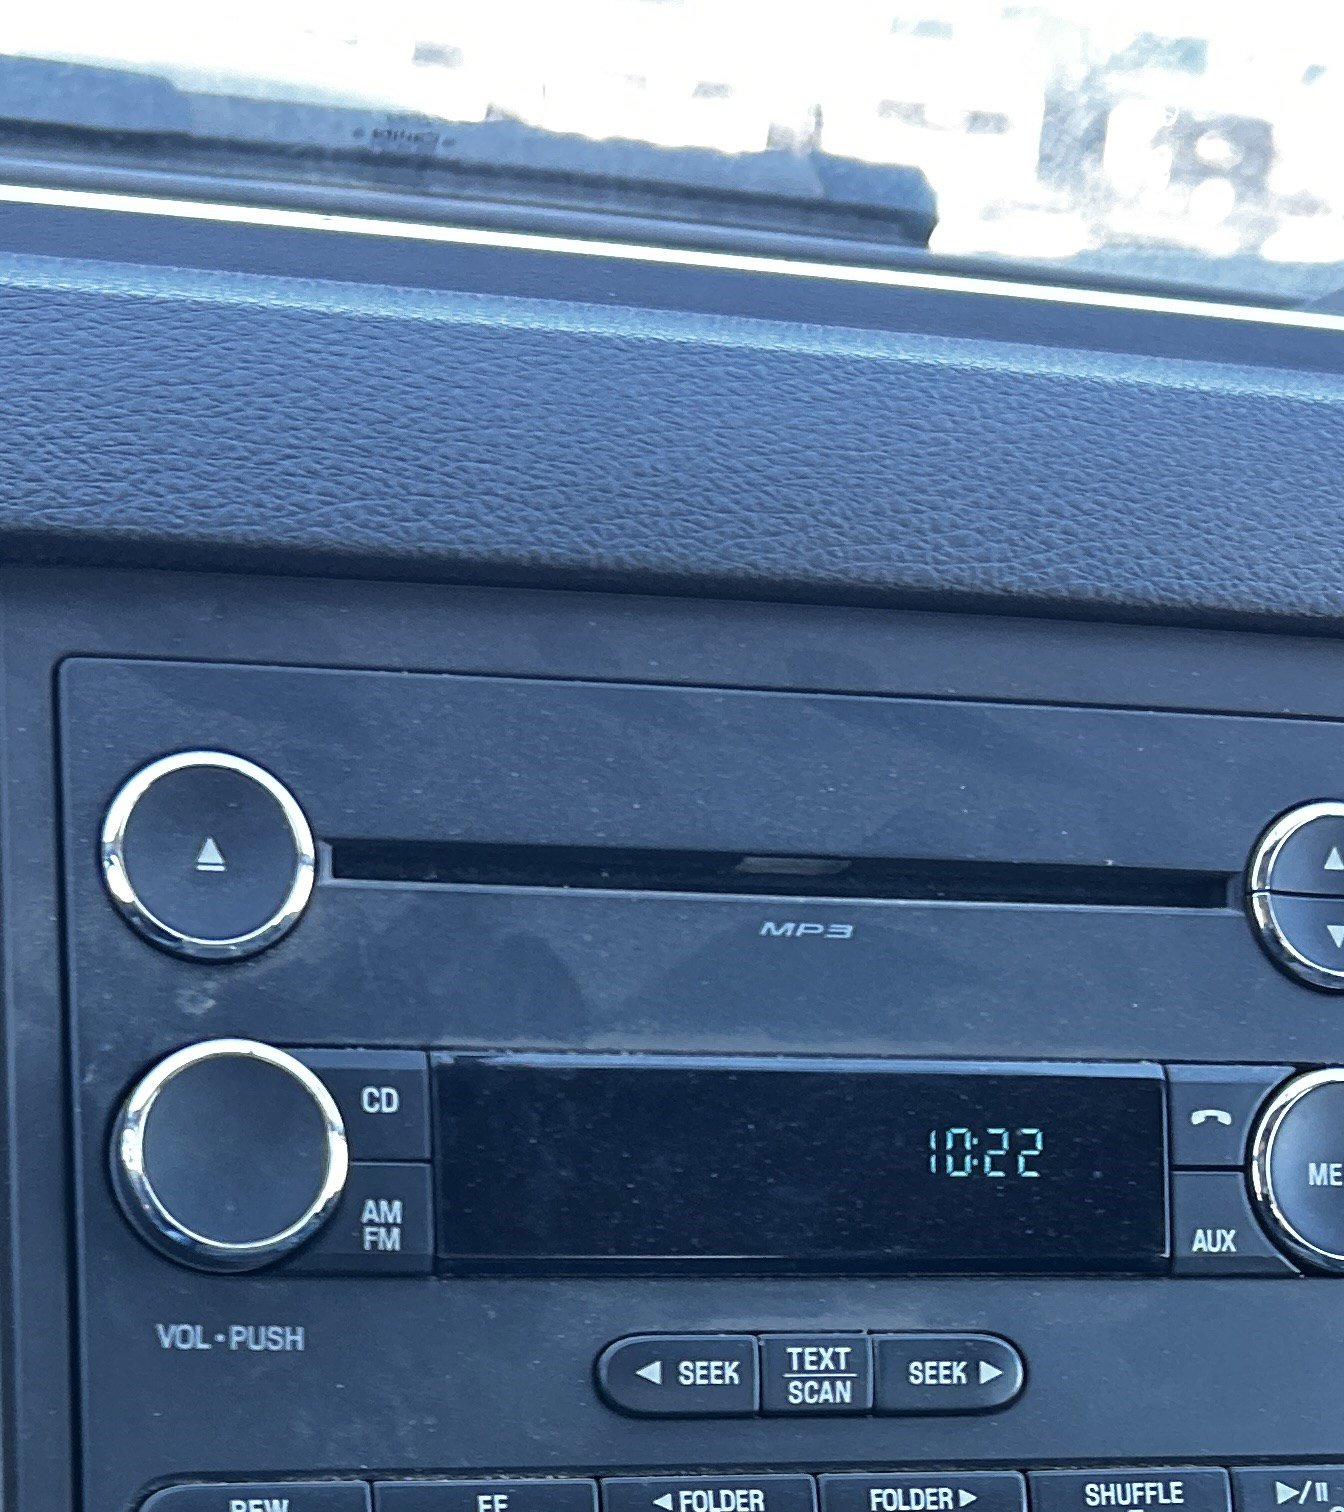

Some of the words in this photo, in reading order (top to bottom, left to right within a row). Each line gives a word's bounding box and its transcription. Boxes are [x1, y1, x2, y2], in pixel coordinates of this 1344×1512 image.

[759, 921, 854, 939] MP3
[362, 1088, 399, 1113] CD
[928, 1127, 1044, 1178] 10:22
[361, 1201, 403, 1224] AM
[363, 1228, 401, 1251] FM
[1191, 1229, 1237, 1253] AUX
[786, 1346, 852, 1371] TEXT
[678, 1360, 740, 1385] SEEK
[908, 1361, 968, 1385] SEEK
[788, 1380, 852, 1404] SCAN
[869, 1487, 953, 1512] FOLDER
[1084, 1482, 1184, 1507] SHUFFLE
